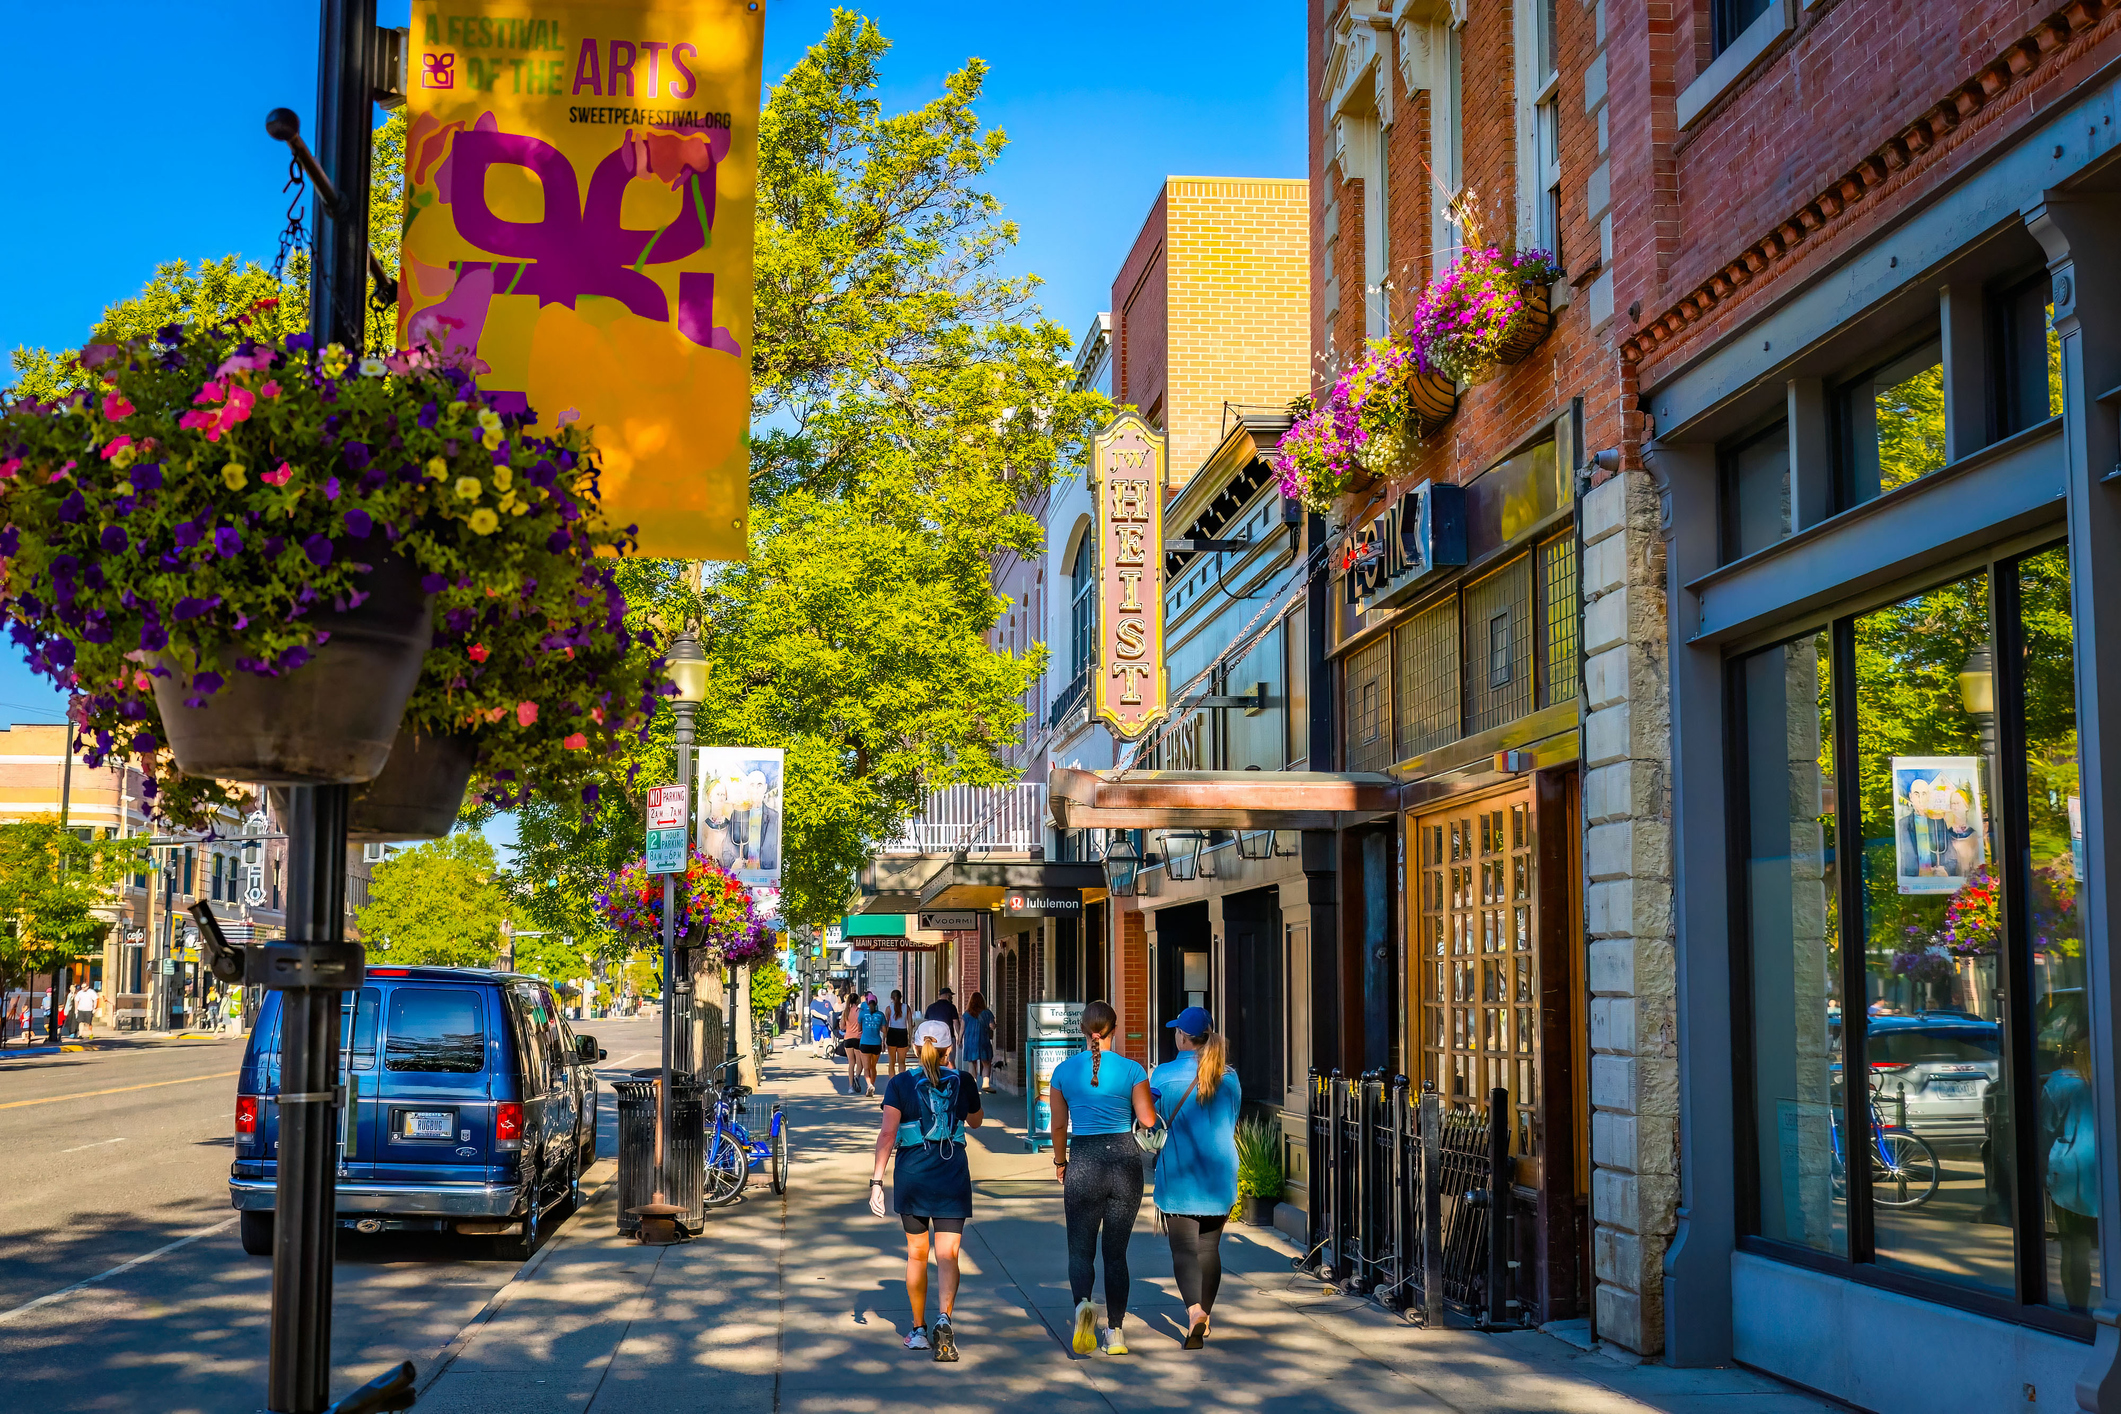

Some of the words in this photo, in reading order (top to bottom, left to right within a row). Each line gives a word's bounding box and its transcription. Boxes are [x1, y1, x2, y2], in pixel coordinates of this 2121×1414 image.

[424, 14, 440, 45] A
[449, 16, 565, 51] FESTIVAL
[466, 56, 501, 92] OF
[509, 57, 565, 96] THE
[572, 37, 698, 99] ARTS
[569, 106, 732, 129] SWEETPEAFESTIVAL.ORG
[1110, 478, 1150, 705] HEIST
[649, 789, 661, 807] NO
[662, 790, 685, 803] PARKING
[650, 832, 658, 849] 2
[665, 831, 680, 840] HOUR
[661, 839, 684, 850] PARKING
[1026, 897, 1079, 909] lululemon
[935, 917, 973, 925] VOORMI
[855, 939, 872, 947] MAIN
[874, 939, 899, 947] STREET
[1063, 1017, 1082, 1026] Stat
[1059, 1026, 1082, 1034] Hoste
[1054, 1049, 1080, 1057] WHERE
[417, 1119, 443, 1131] RUGBUG
